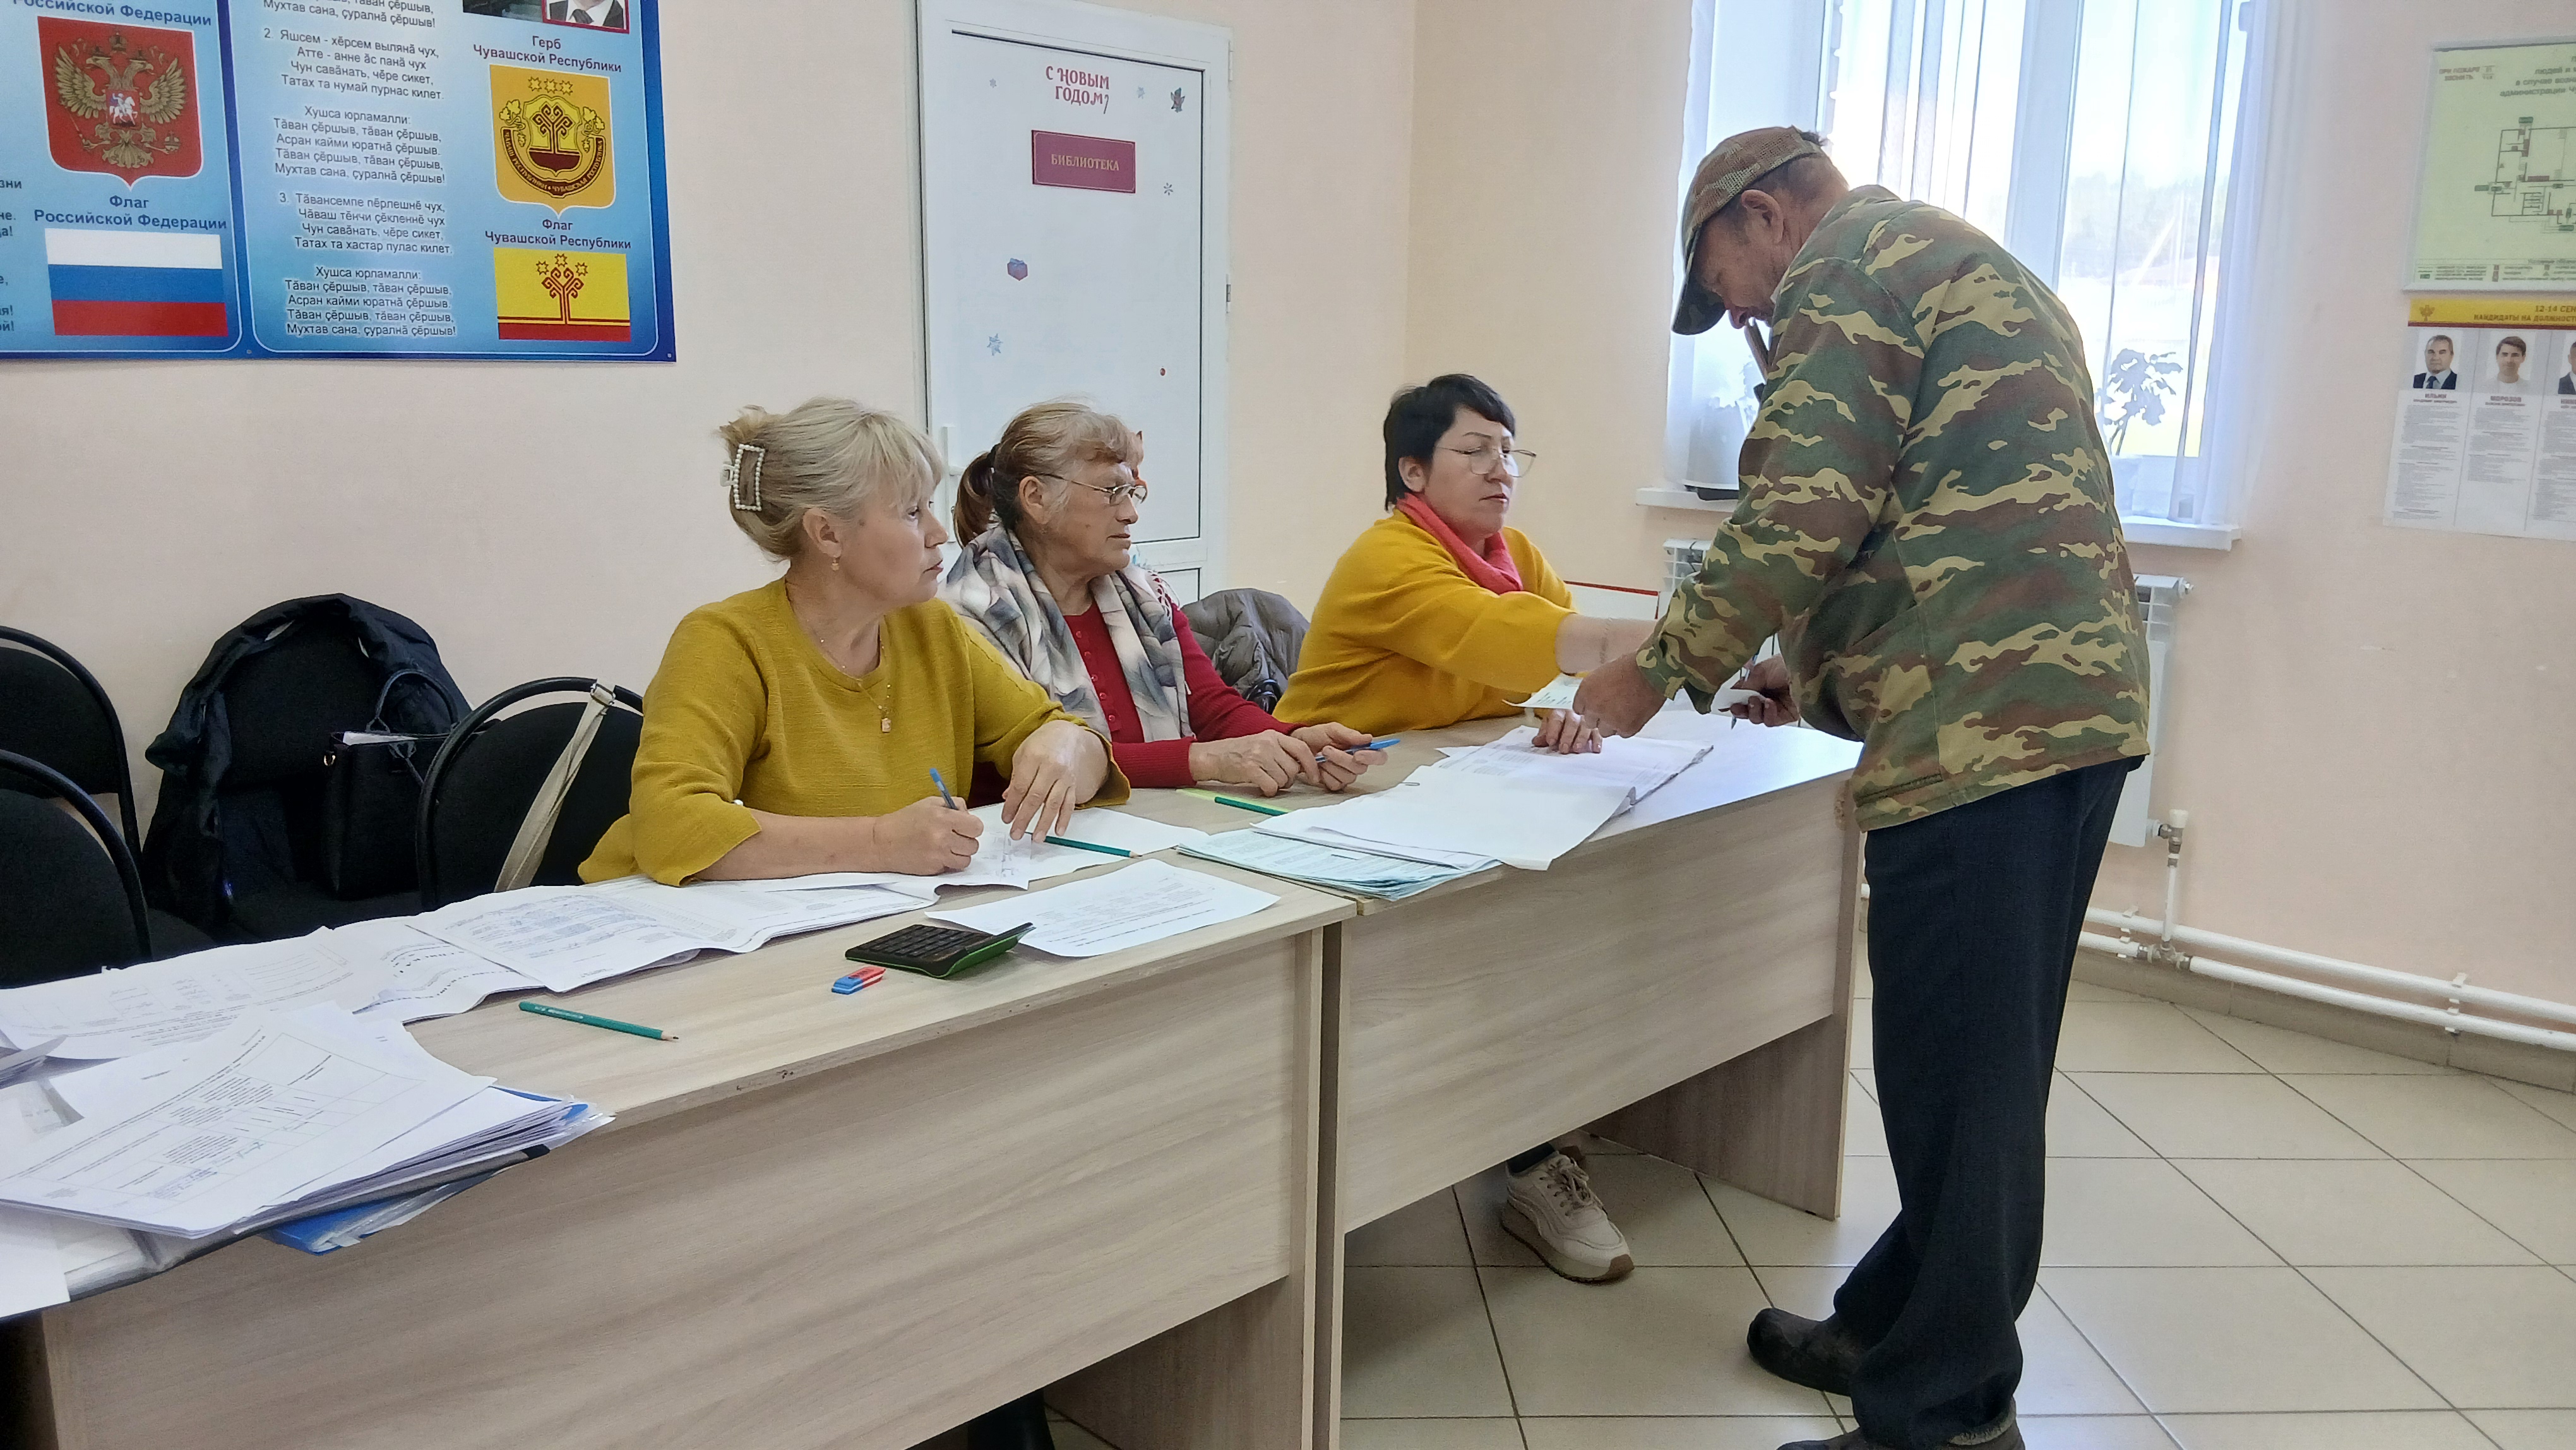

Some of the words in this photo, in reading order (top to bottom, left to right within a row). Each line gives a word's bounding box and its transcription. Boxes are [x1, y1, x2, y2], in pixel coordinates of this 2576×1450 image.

[121, 4, 212, 26] Федерации
[264, 0, 305, 12] Мухтав
[309, 6, 338, 18] сана,
[280, 30, 321, 44] Яшсем
[532, 35, 561, 51] Герб
[297, 47, 323, 58] Атте
[335, 52, 361, 63] анне
[408, 60, 426, 71] чух
[474, 44, 545, 64] Чувашской
[549, 53, 621, 73] Республики
[291, 61, 312, 74] Чун
[281, 75, 314, 87] Татах
[318, 80, 330, 88] та
[334, 82, 367, 92] нумай
[371, 85, 408, 96] пурнас
[1046, 66, 1053, 80] С
[1057, 68, 1109, 90] НОВЫМ
[304, 105, 340, 119] Хушса
[345, 112, 411, 124] юрламалли:
[277, 133, 311, 147] Асран
[315, 138, 348, 148] кайми
[275, 163, 316, 176] Мухтав
[1051, 153, 1119, 171] БИБЛИОТЕКА
[109, 195, 149, 208] Флаг
[34, 209, 133, 225] Российской
[138, 215, 227, 231] Федерации
[427, 218, 445, 227] чух
[542, 219, 573, 230] Флаг
[302, 223, 323, 236] Чун
[294, 237, 327, 248] Татах
[331, 241, 342, 249] та
[346, 241, 383, 252] хастар
[386, 243, 417, 253] пулас
[485, 231, 556, 245] Чувашской
[560, 234, 631, 249] Республики
[316, 267, 352, 279] Хушса
[355, 270, 421, 280] юрламалли:
[289, 295, 323, 306] Асран
[326, 296, 359, 306] кайми
[287, 323, 328, 335] Мухтав
